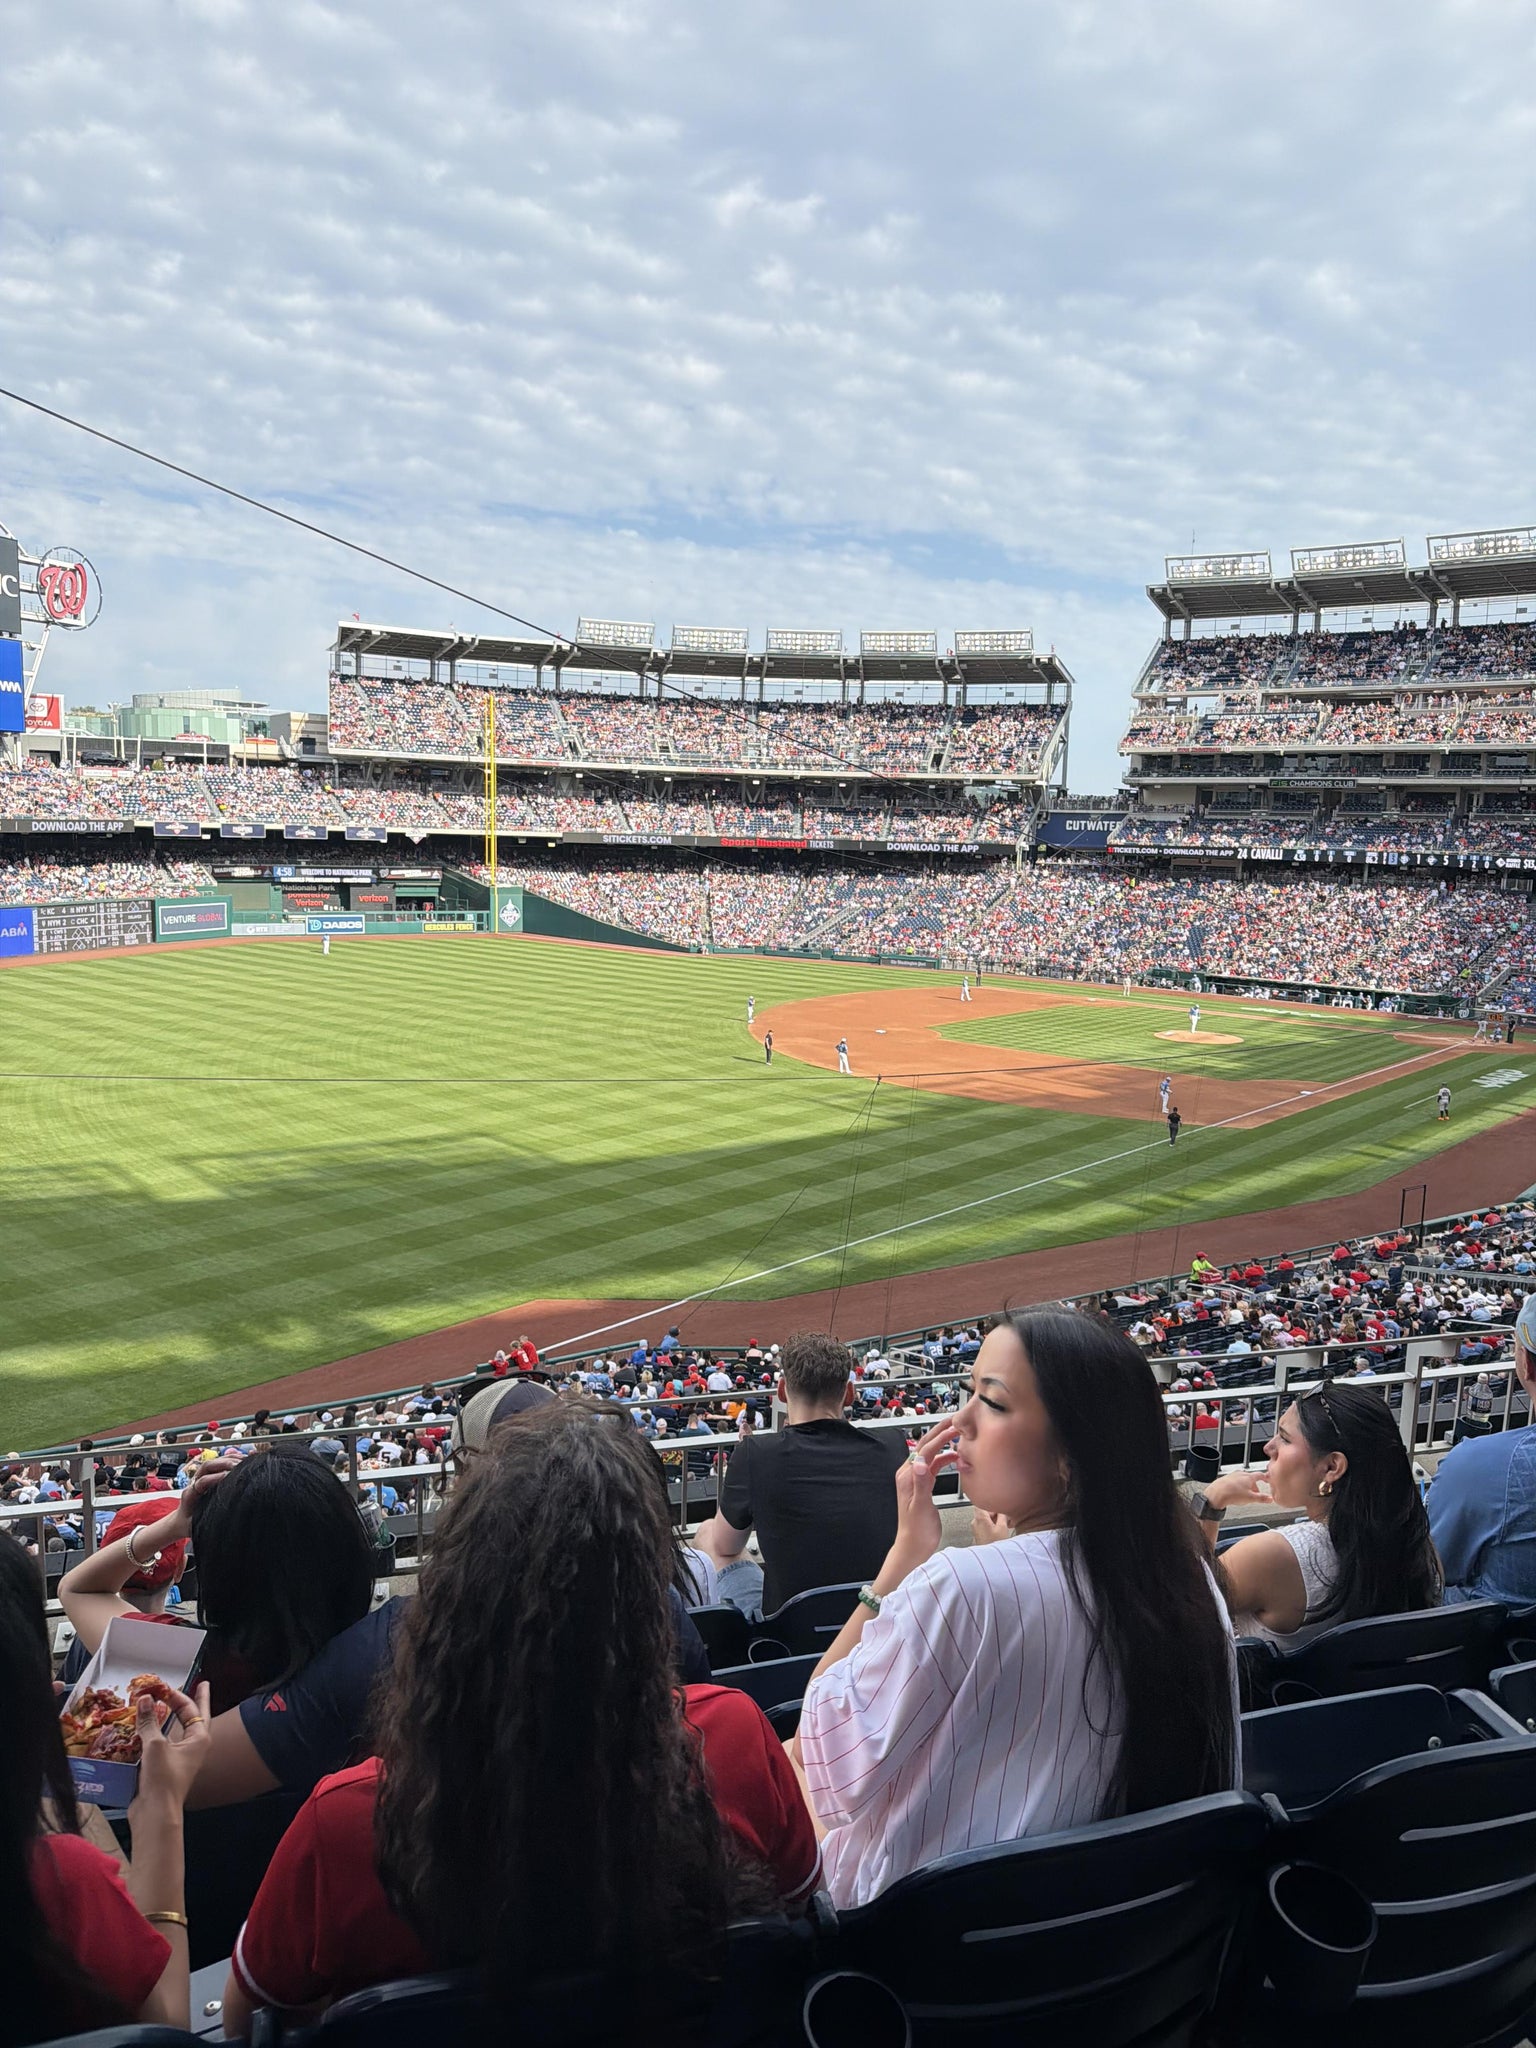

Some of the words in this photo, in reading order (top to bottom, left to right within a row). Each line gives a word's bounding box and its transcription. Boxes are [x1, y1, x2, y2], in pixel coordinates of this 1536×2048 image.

[0, 574, 18, 598] C
[1289, 780, 1332, 788] CHAMPIONS
[1334, 780, 1354, 788] CLUB
[32, 821, 87, 832] DOWNLOAD
[89, 821, 106, 831] THE
[107, 821, 124, 831] APP
[603, 834, 672, 845] SITICKETS.COM
[720, 838, 755, 847] Sports
[756, 838, 807, 849] Illustrated
[809, 840, 834, 849] TICKETS
[887, 842, 940, 852] DOWNLOAD
[942, 843, 960, 852] THE
[962, 844, 980, 852] APP
[1163, 848, 1204, 856] DOWNLOAD
[1237, 847, 1248, 860] 24
[1250, 847, 1283, 860] CAVALLI
[1416, 854, 1421, 864] 1
[1443, 855, 1449, 866] 5
[1484, 861, 1490, 869] 0
[276, 868, 293, 876] 4:58
[359, 894, 388, 902] verizon
[163, 914, 196, 924] VENTURE
[322, 921, 362, 929] DABOS
[0, 927, 27, 938] ABM
[1366, 1326, 1377, 1340] 25
[929, 1345, 943, 1356] 28
[382, 1452, 391, 1463] 5
